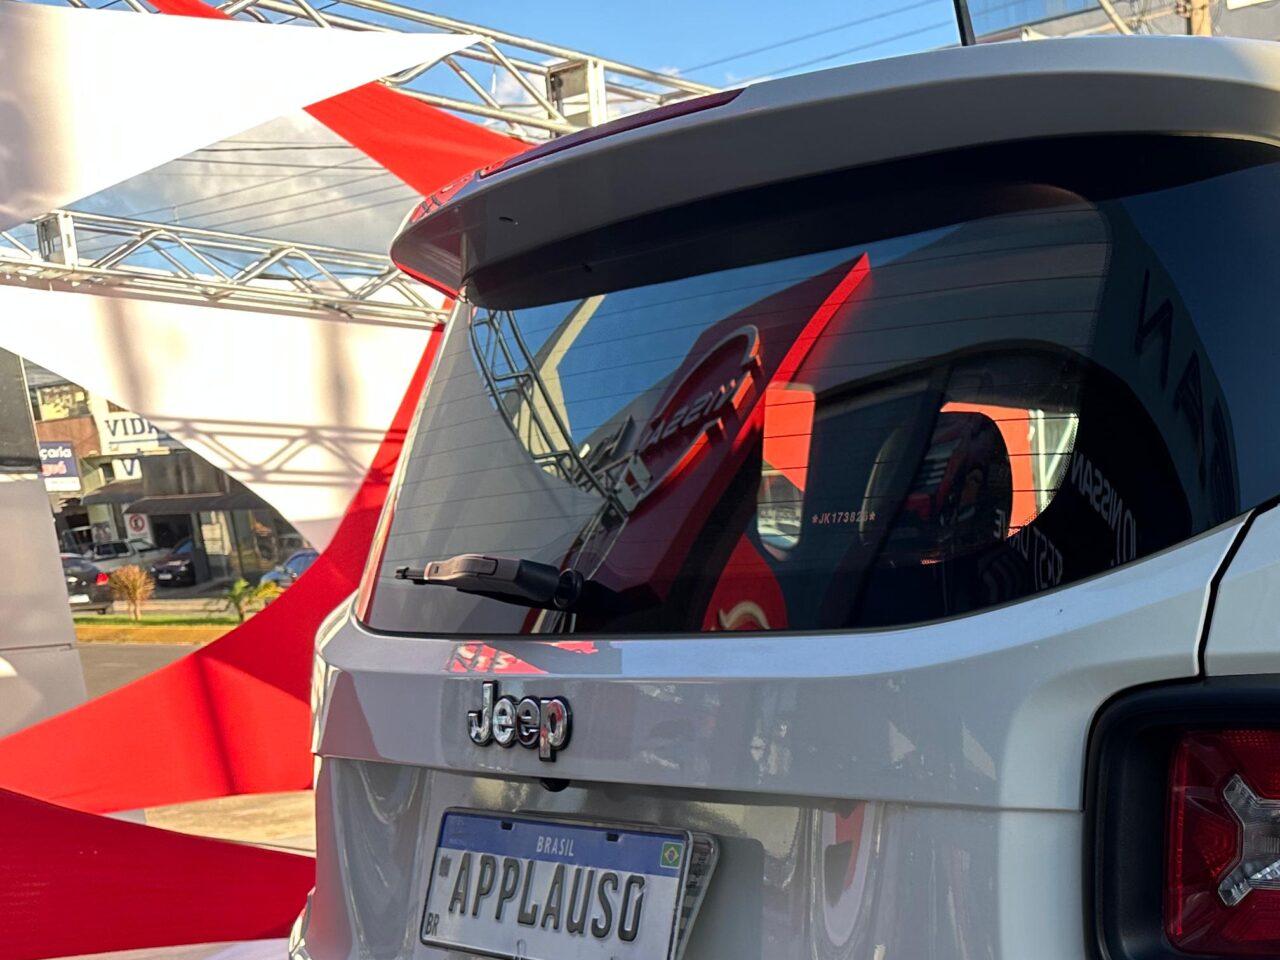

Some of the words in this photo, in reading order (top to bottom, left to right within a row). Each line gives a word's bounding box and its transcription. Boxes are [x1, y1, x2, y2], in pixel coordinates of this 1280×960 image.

[467, 679, 573, 763] Jeep
[536, 835, 575, 857] BRASIL
[425, 911, 440, 937] BR
[448, 852, 646, 942] APPLAUSO
